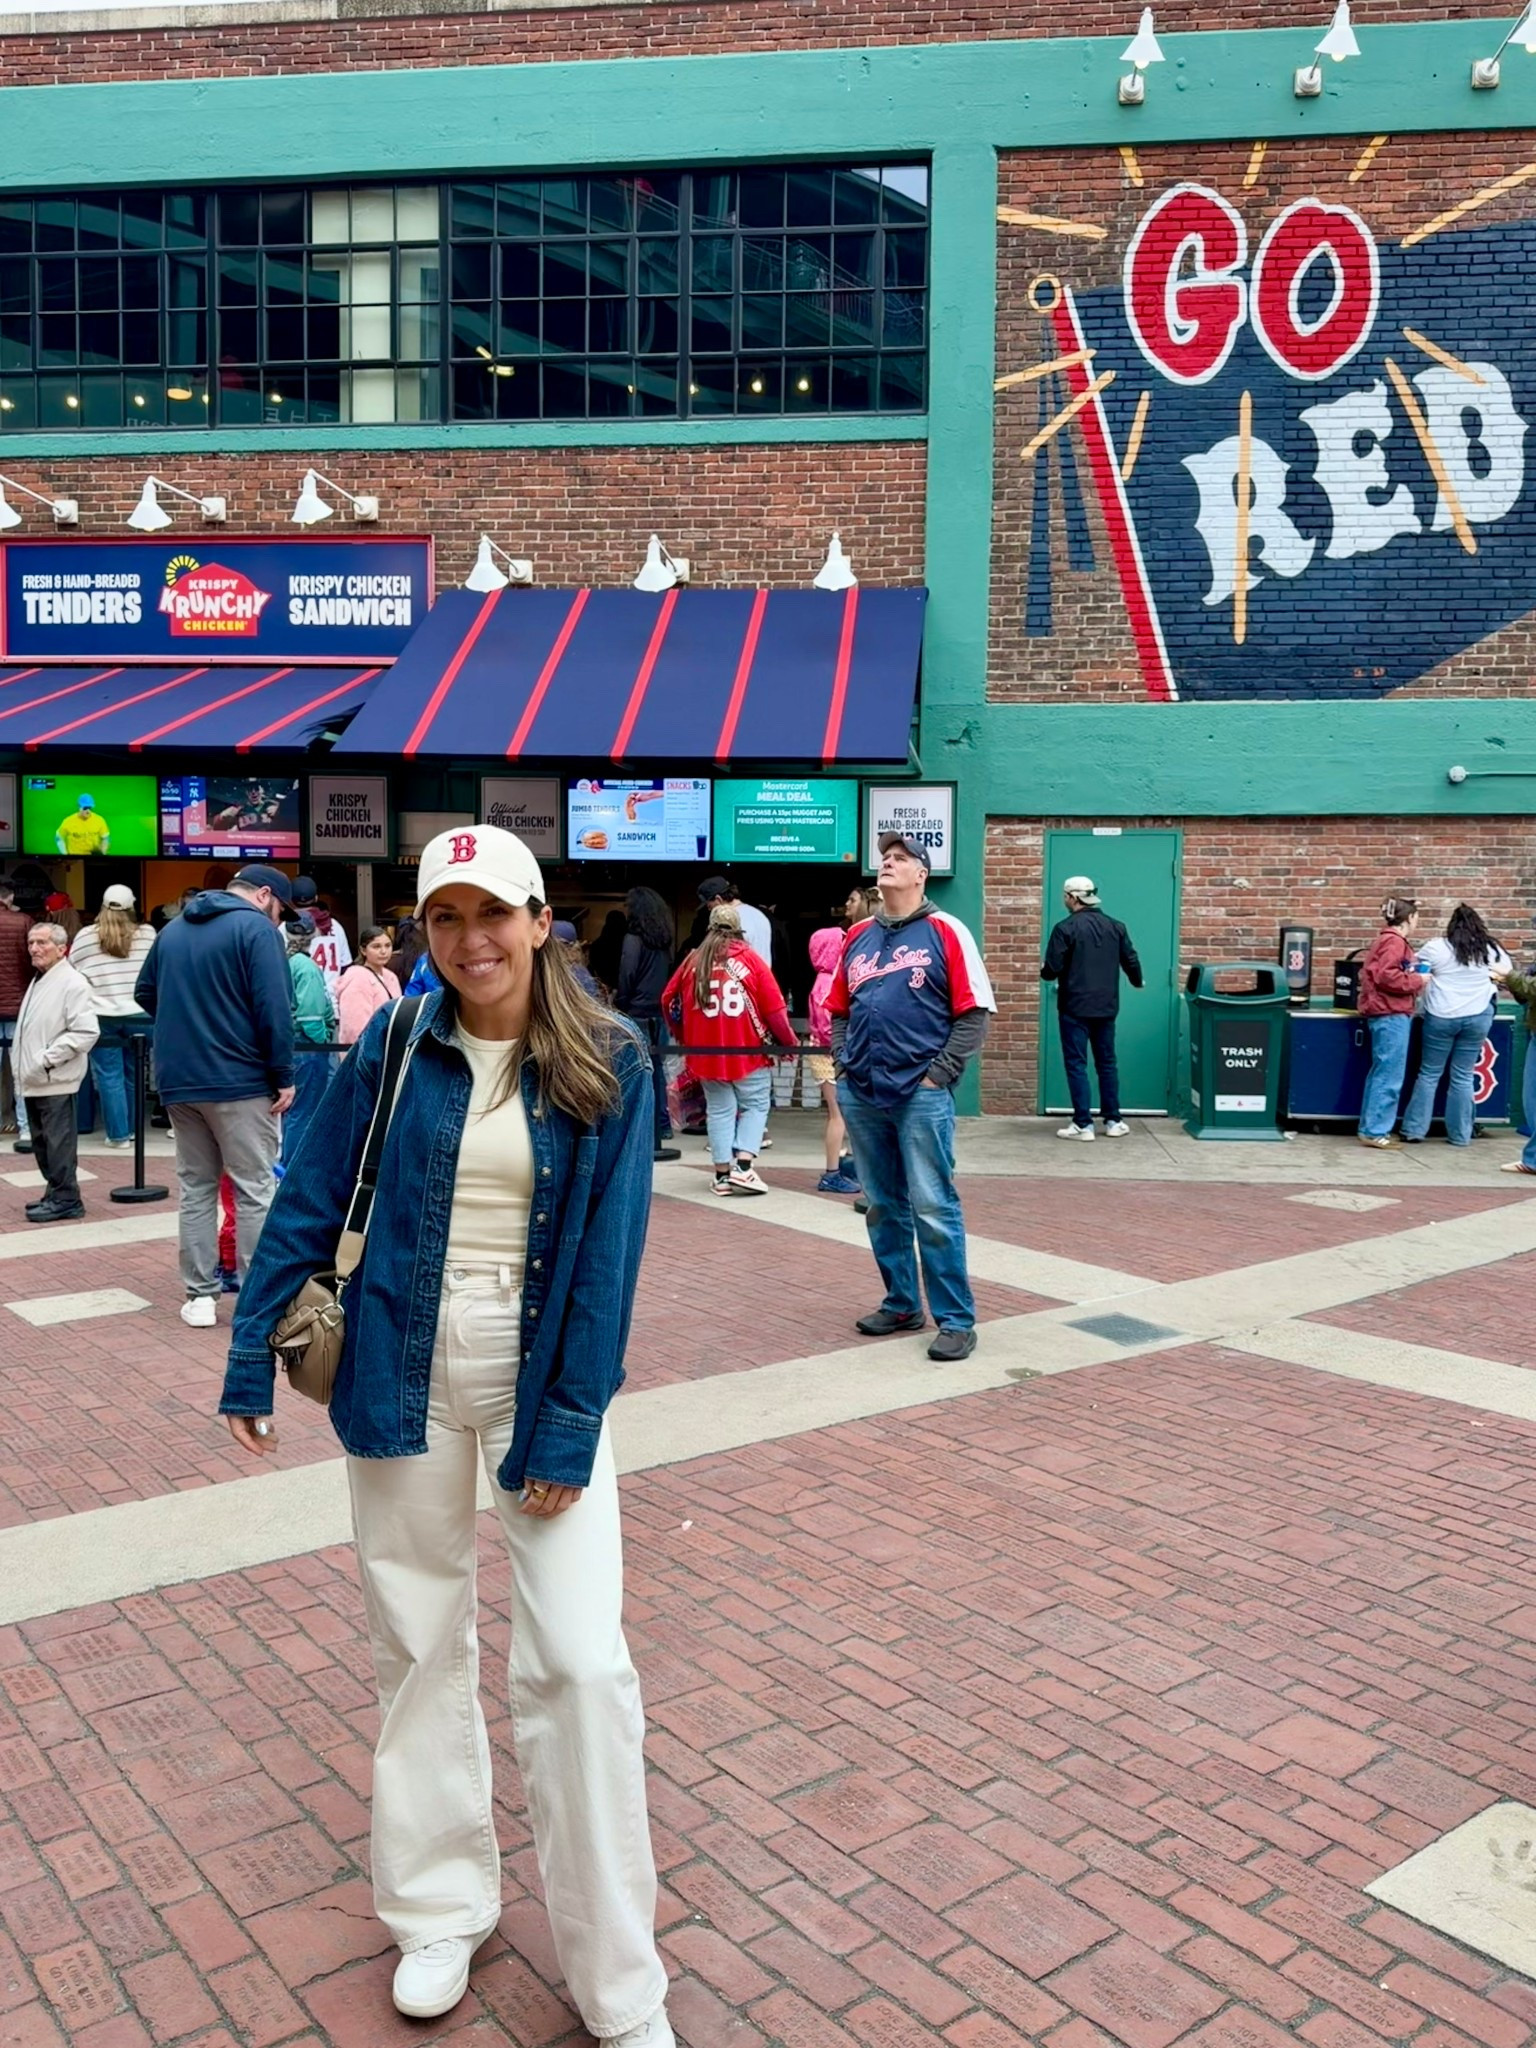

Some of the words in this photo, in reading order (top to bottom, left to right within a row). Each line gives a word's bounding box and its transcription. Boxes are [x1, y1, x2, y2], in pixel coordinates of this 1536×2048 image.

[1123, 183, 1380, 385] GO
[1180, 361, 1529, 606] RED
[22, 574, 53, 589] FRESH
[54, 574, 62, 589] &
[63, 573, 141, 589] HAND-BREADED
[188, 579, 239, 590] KRISPY
[289, 575, 345, 596] KRISPY
[346, 575, 411, 596] CHICKEN
[22, 590, 142, 625] TENDERS
[158, 587, 271, 619] KRUNCHY
[288, 597, 412, 626] SANDWICH
[183, 620, 246, 631] CHICKEN
[762, 781, 808, 791] Mastercard
[329, 793, 368, 807] KRISPY
[756, 791, 785, 802] MEAL
[786, 791, 814, 802] DEAL
[326, 808, 371, 822] CHICKEN
[490, 802, 527, 816] Official
[893, 807, 919, 819] FRESH
[514, 815, 555, 829] CHICKEN
[877, 819, 944, 830] HAND-BREADED
[315, 823, 382, 839] SANDWICH
[616, 832, 657, 842] SANDWICH
[448, 832, 478, 865] B
[312, 943, 339, 971] 41
[885, 944, 932, 971] Sox
[1288, 949, 1305, 971] B
[1220, 1046, 1263, 1057] TRASH
[1225, 1058, 1258, 1068] ONLY
